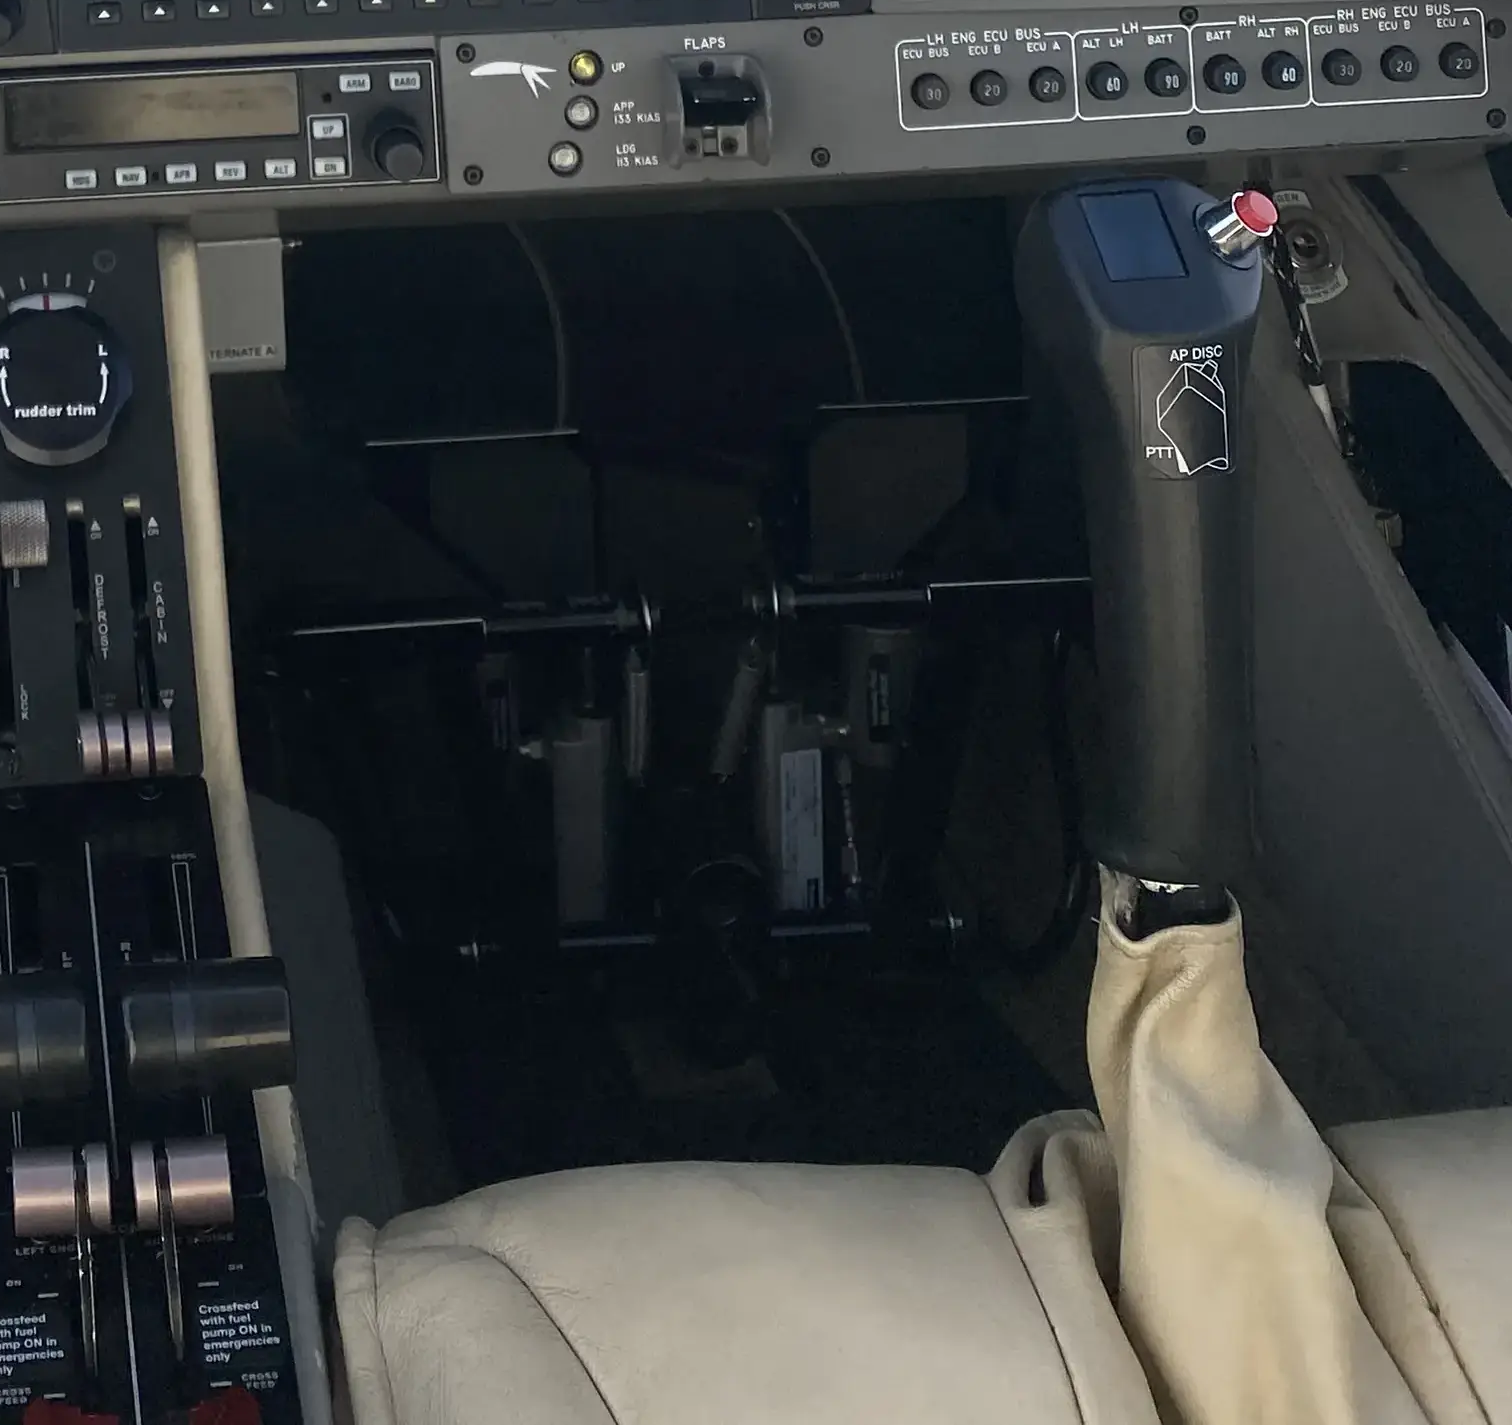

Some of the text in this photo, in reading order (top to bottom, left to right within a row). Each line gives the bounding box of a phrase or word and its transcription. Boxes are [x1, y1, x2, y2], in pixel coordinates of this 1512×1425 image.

[684, 37, 725, 51] FLAPS
[927, 28, 1041, 46] LH ENG ECU BUS
[1148, 34, 1172, 45] BATT
[612, 62, 625, 73] UP
[14, 403, 96, 419] rudder trim
[1146, 446, 1174, 459] PTT
[95, 575, 109, 660] DEFROST
[153, 582, 167, 643] CABIN
[199, 1301, 259, 1315] Crossfeed
[14, 1326, 37, 1337] fuel
[24, 1338, 42, 1348] ON
[46, 1336, 56, 1346] in
